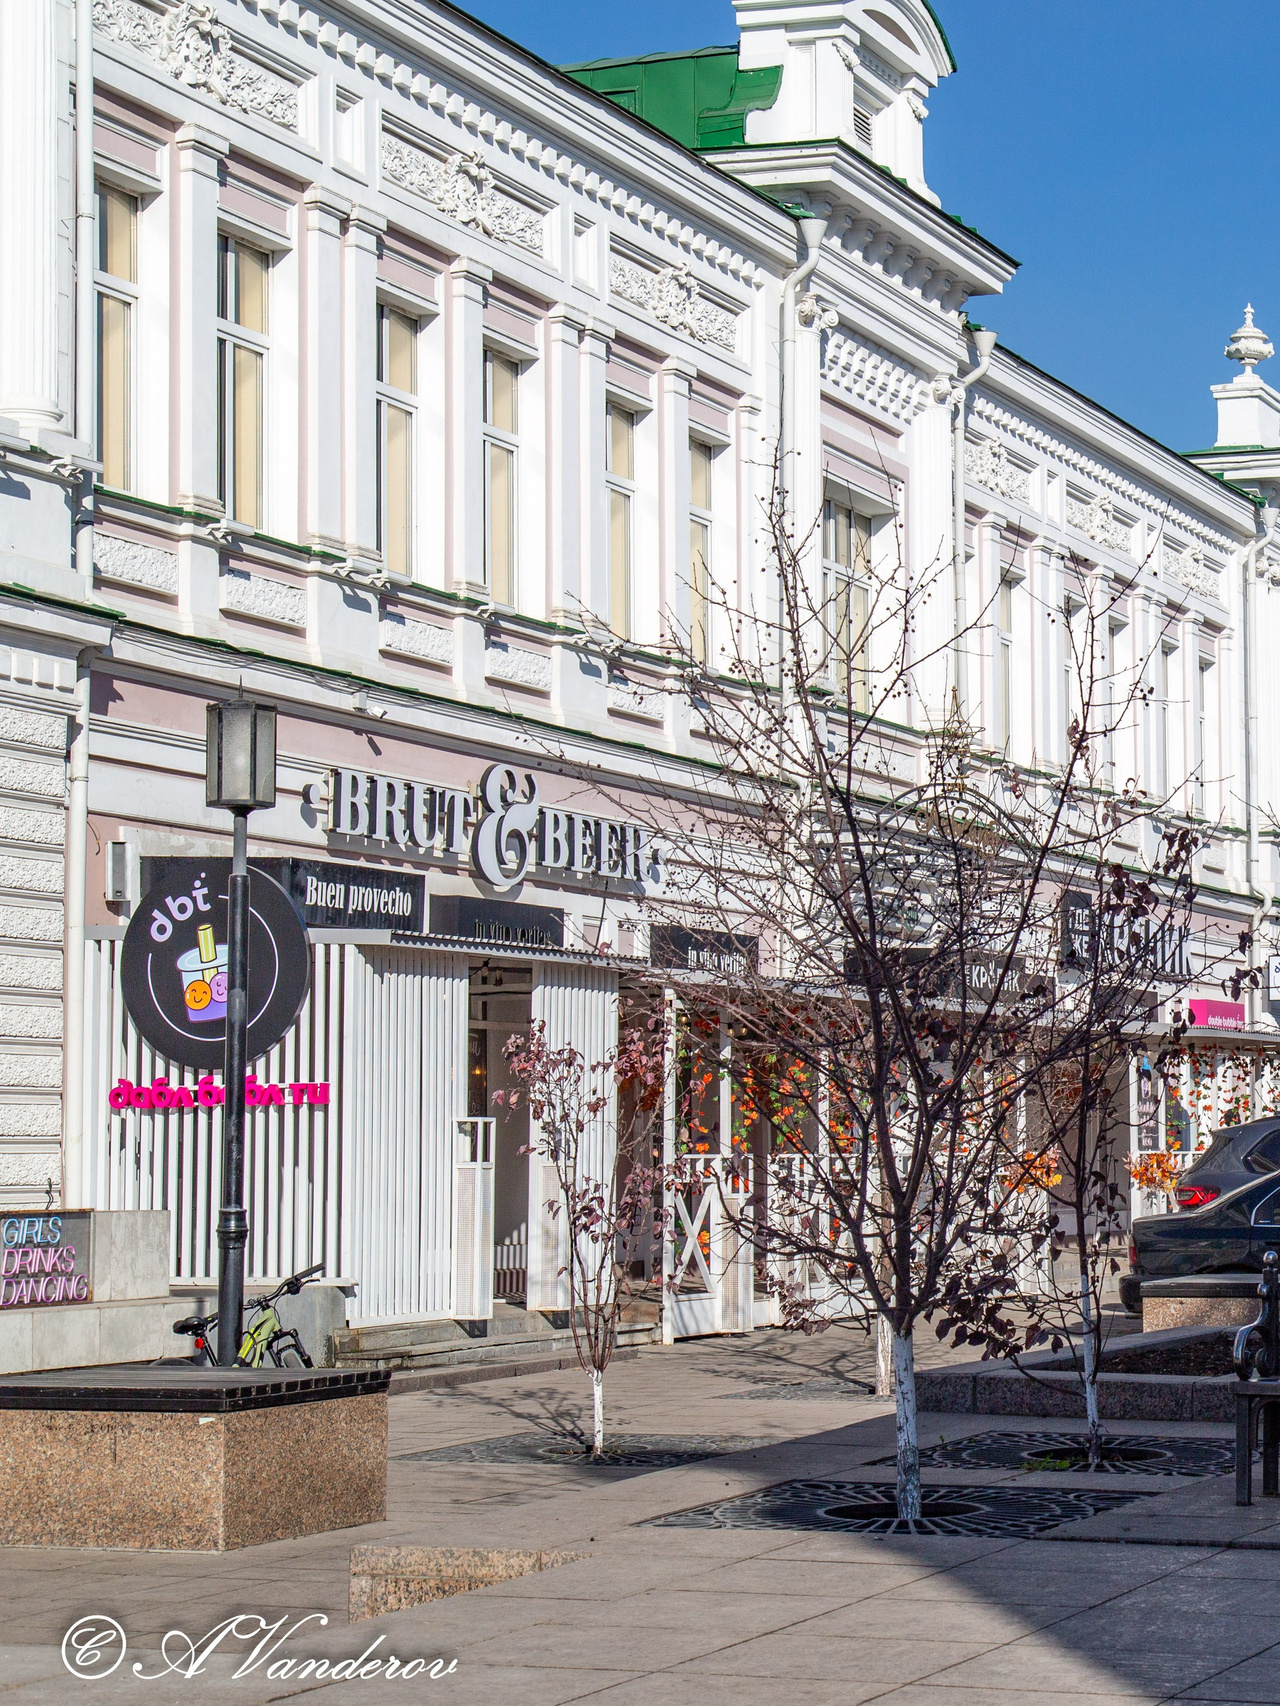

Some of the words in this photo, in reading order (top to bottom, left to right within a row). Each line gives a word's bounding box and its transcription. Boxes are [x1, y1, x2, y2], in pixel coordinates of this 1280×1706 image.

[329, 767, 475, 853] BRUT
[471, 763, 540, 887] &
[538, 807, 652, 883] BEER
[150, 872, 212, 942] dbt
[305, 875, 345, 909] Buen
[348, 885, 412, 917] provecho
[688, 946, 697, 969] in
[720, 952, 748, 976] verita
[1207, 1014, 1222, 1027] double
[1222, 1016, 1237, 1029] bubble
[108, 1078, 195, 1109] дабл
[198, 1075, 285, 1107] ббл
[288, 1083, 331, 1105] ти
[3, 1216, 62, 1246] GIRLS
[2, 1245, 76, 1276] DRINKS
[0, 1273, 88, 1306] DANCING
